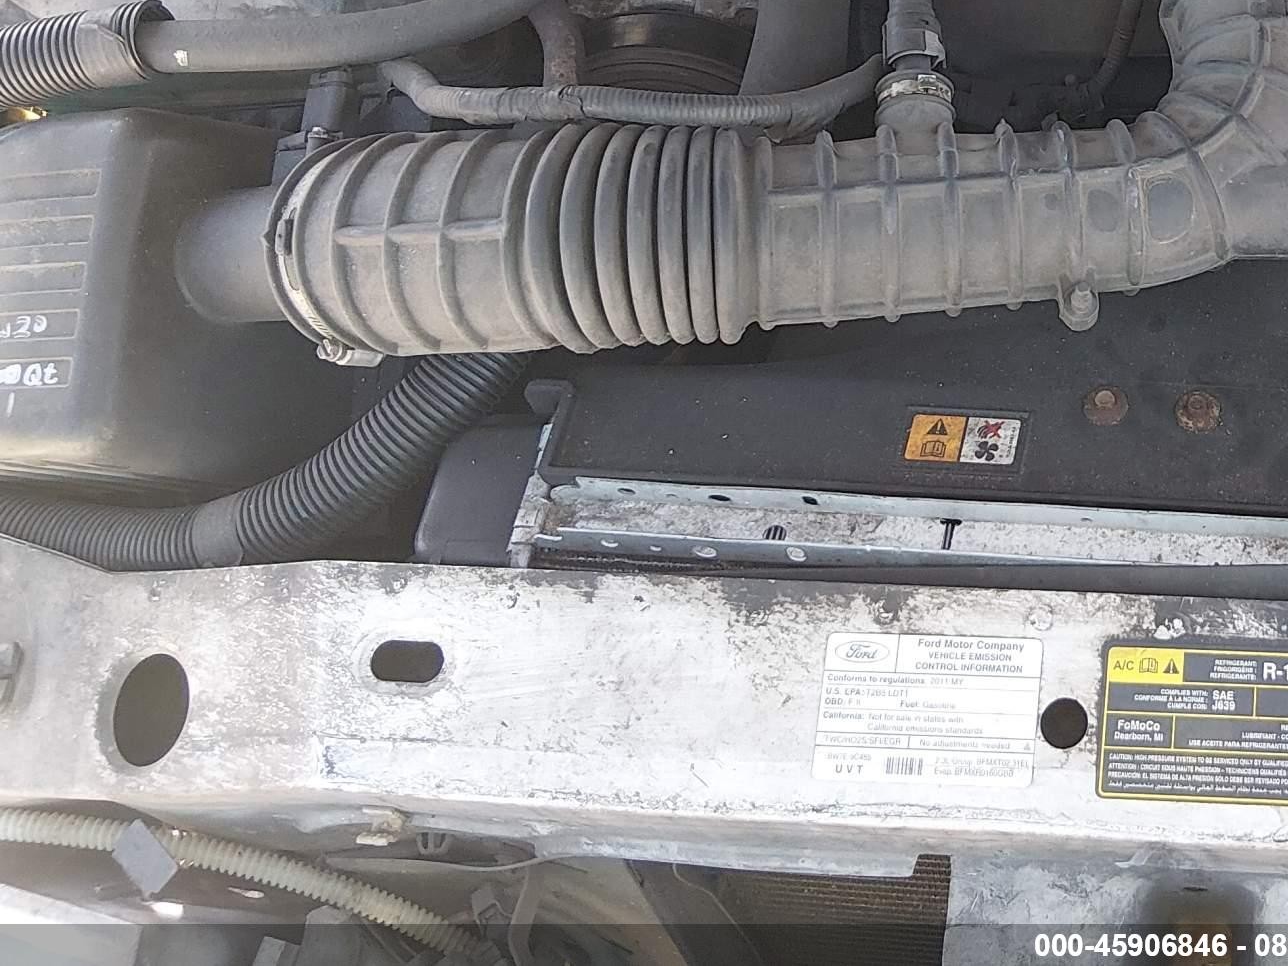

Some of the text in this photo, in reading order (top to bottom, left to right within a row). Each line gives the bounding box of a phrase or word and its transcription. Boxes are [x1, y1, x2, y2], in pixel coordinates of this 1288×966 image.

[917, 638, 1024, 652] Ford Motor Company
[845, 644, 877, 659] Ford
[928, 651, 1011, 661] VEHICLE EMISSION
[915, 662, 1022, 673] CONTROL INFORMATION
[1113, 659, 1134, 670] A/C
[827, 674, 867, 682] Conforms
[825, 687, 840, 695] U.S.
[1212, 690, 1234, 700] SAE
[1211, 700, 1235, 710] J639
[822, 710, 865, 720] California:
[905, 724, 942, 733] emissions
[944, 726, 983, 735] standards
[1117, 719, 1160, 731] FoMoCo
[1114, 731, 1152, 741] Dearborn,
